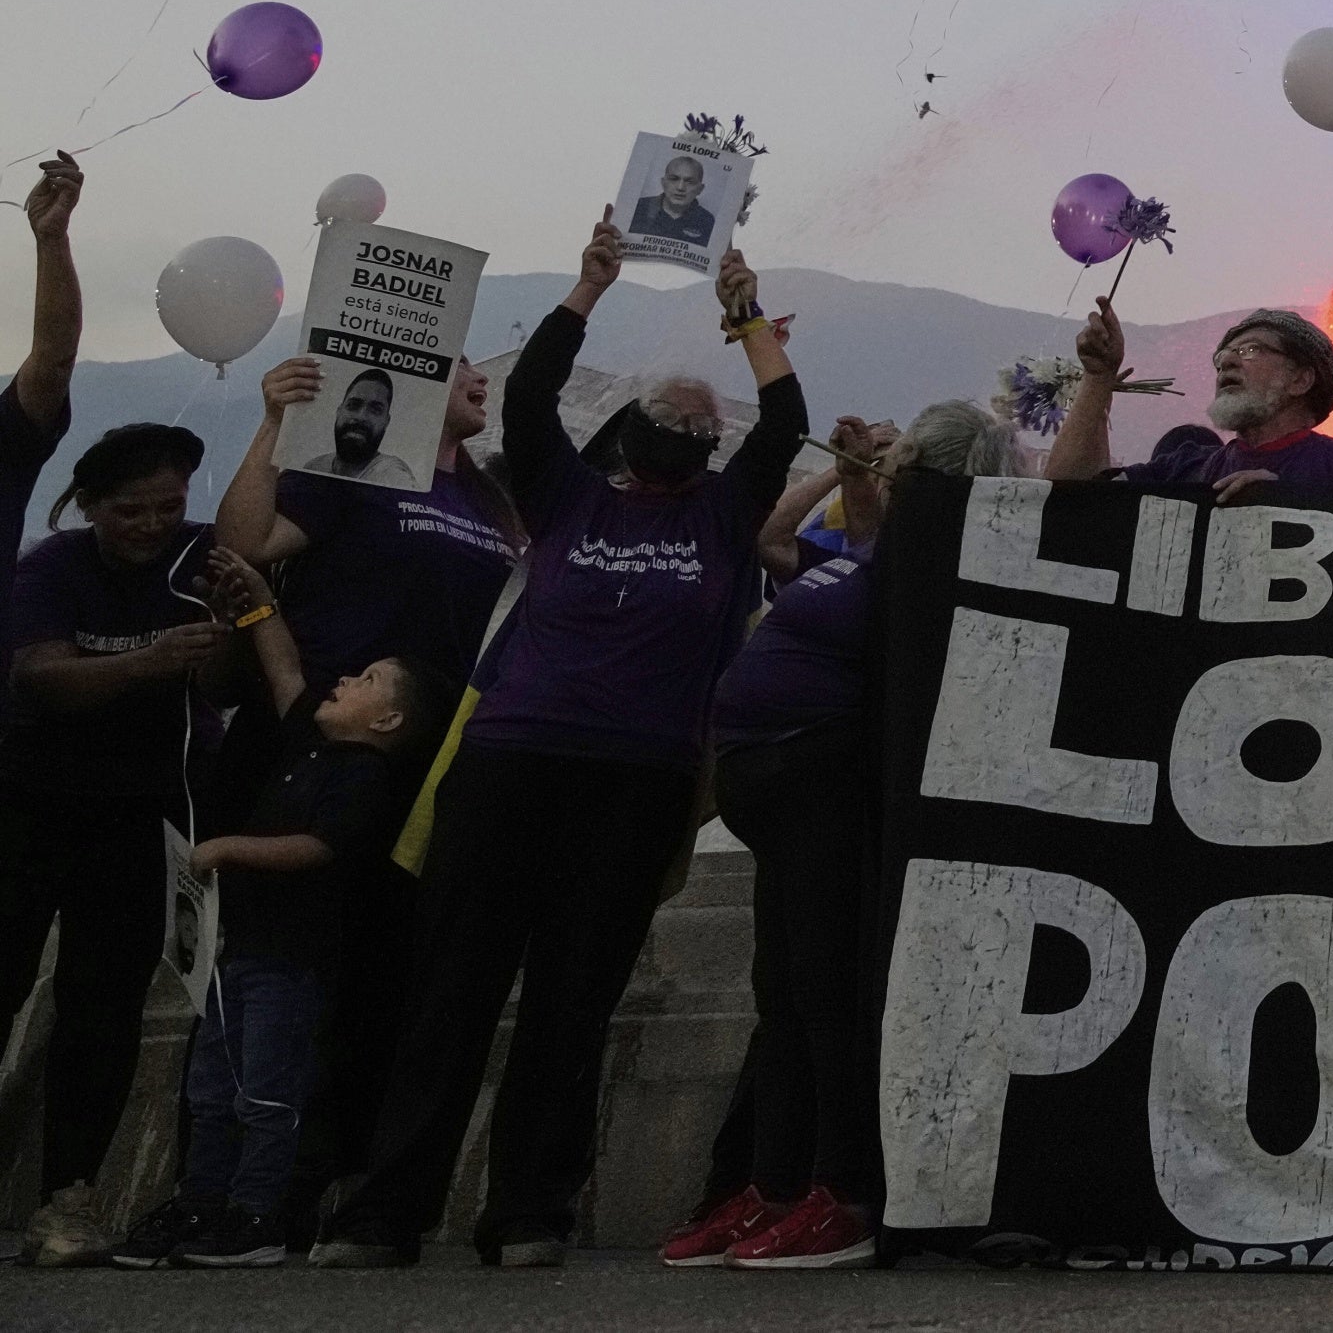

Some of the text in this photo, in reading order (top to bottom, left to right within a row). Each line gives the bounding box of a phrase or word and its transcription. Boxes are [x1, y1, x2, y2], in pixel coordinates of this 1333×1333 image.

[672, 141, 720, 160] LUIS LOPEZ
[643, 235, 689, 251] PERIODISTA
[658, 246, 671, 254] NO
[672, 249, 682, 257] ES
[683, 251, 711, 265] DELITO
[356, 241, 453, 279] JOSNAR
[352, 267, 446, 306] BADUEL
[344, 295, 439, 327] está siendo
[339, 310, 439, 348] torturado
[325, 336, 439, 375] EN EL RODEO
[399, 519, 405, 532] Y
[408, 519, 436, 532] PONER
[436, 521, 447, 533] EN
[482, 538, 496, 551] LOS
[660, 540, 674, 555] LOS
[605, 561, 647, 573] LIBERTAD
[652, 556, 668, 571] LOS
